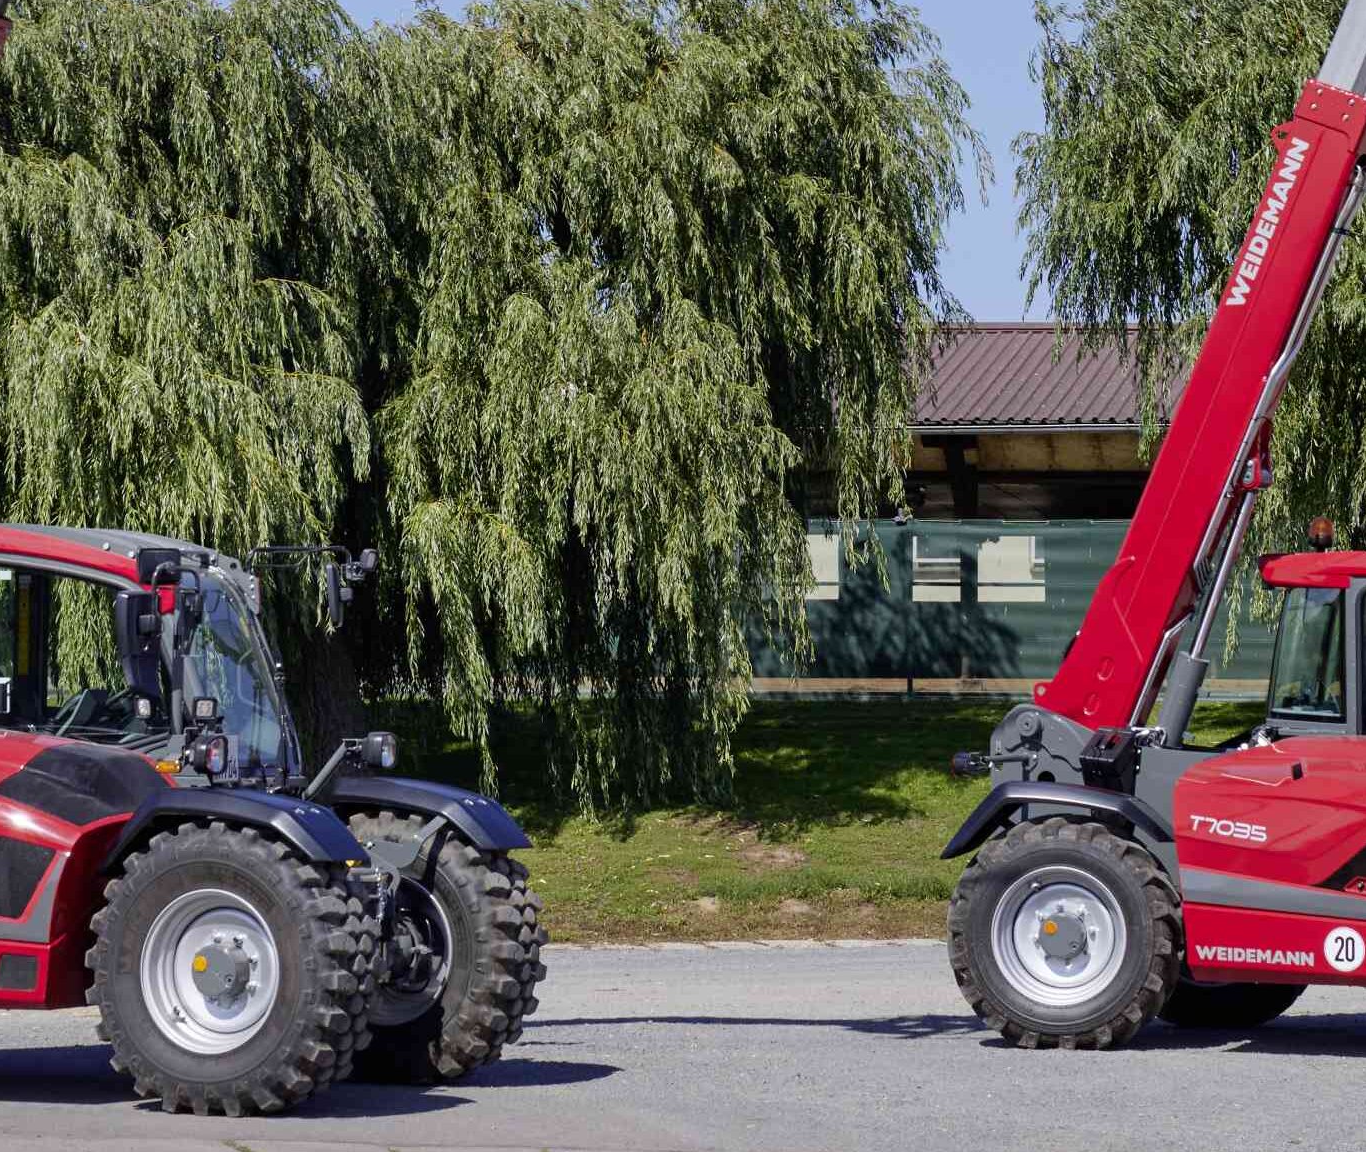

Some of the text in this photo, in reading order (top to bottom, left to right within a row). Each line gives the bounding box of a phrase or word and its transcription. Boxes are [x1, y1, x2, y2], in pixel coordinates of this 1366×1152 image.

[1225, 136, 1311, 307] WEIDEMANN
[1190, 815, 1267, 842] T7035
[1195, 945, 1315, 967] WEIDEMANN
[1334, 936, 1355, 962] 20
